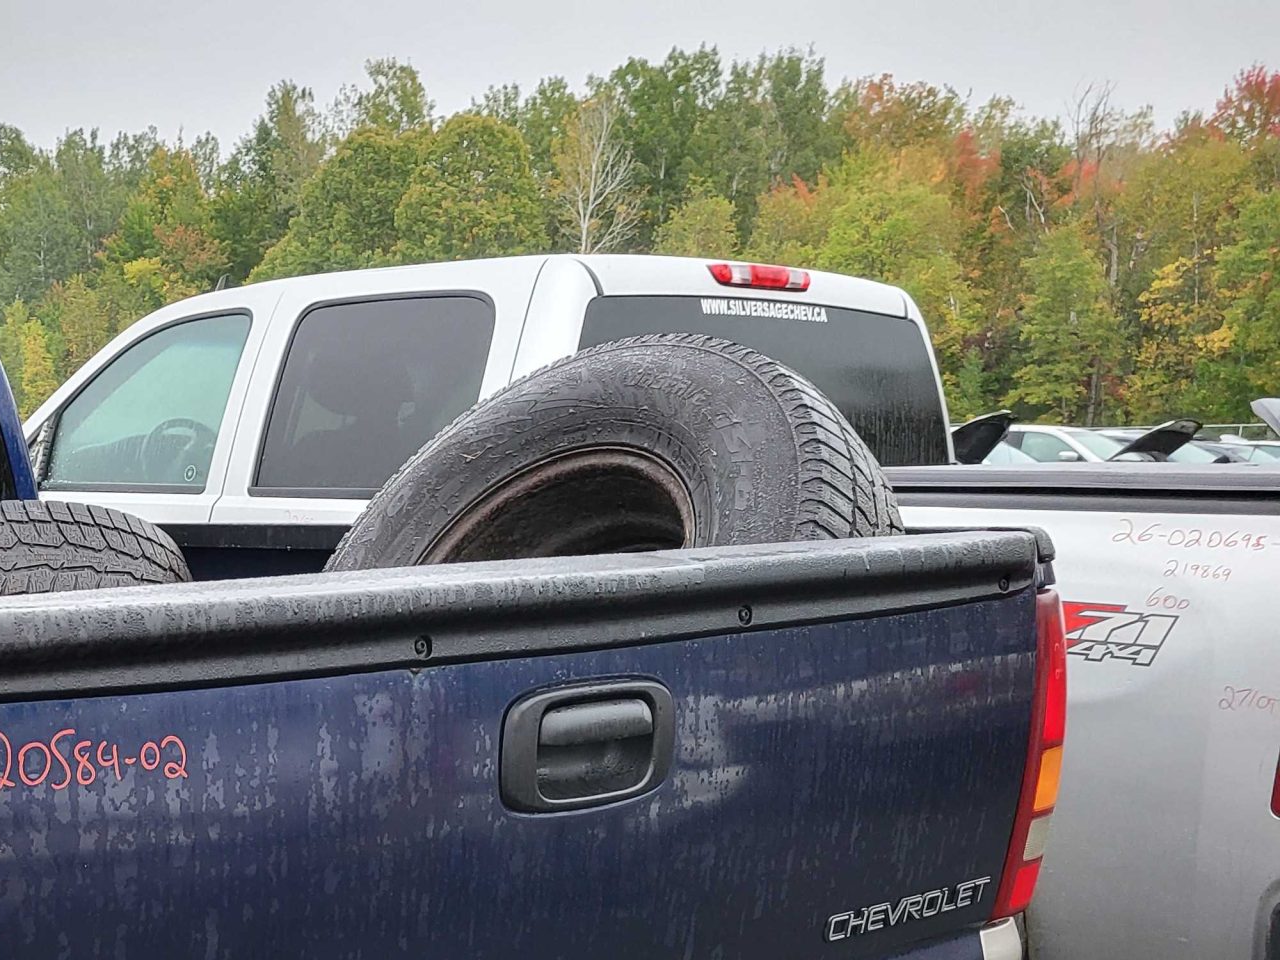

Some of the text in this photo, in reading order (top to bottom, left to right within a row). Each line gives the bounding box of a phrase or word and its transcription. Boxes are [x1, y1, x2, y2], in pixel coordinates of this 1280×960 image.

[700, 299, 828, 323] WWW.SILVERSAGECHEV.CA
[1163, 559, 1232, 582] 219869
[828, 876, 991, 941] CHEVROLET
